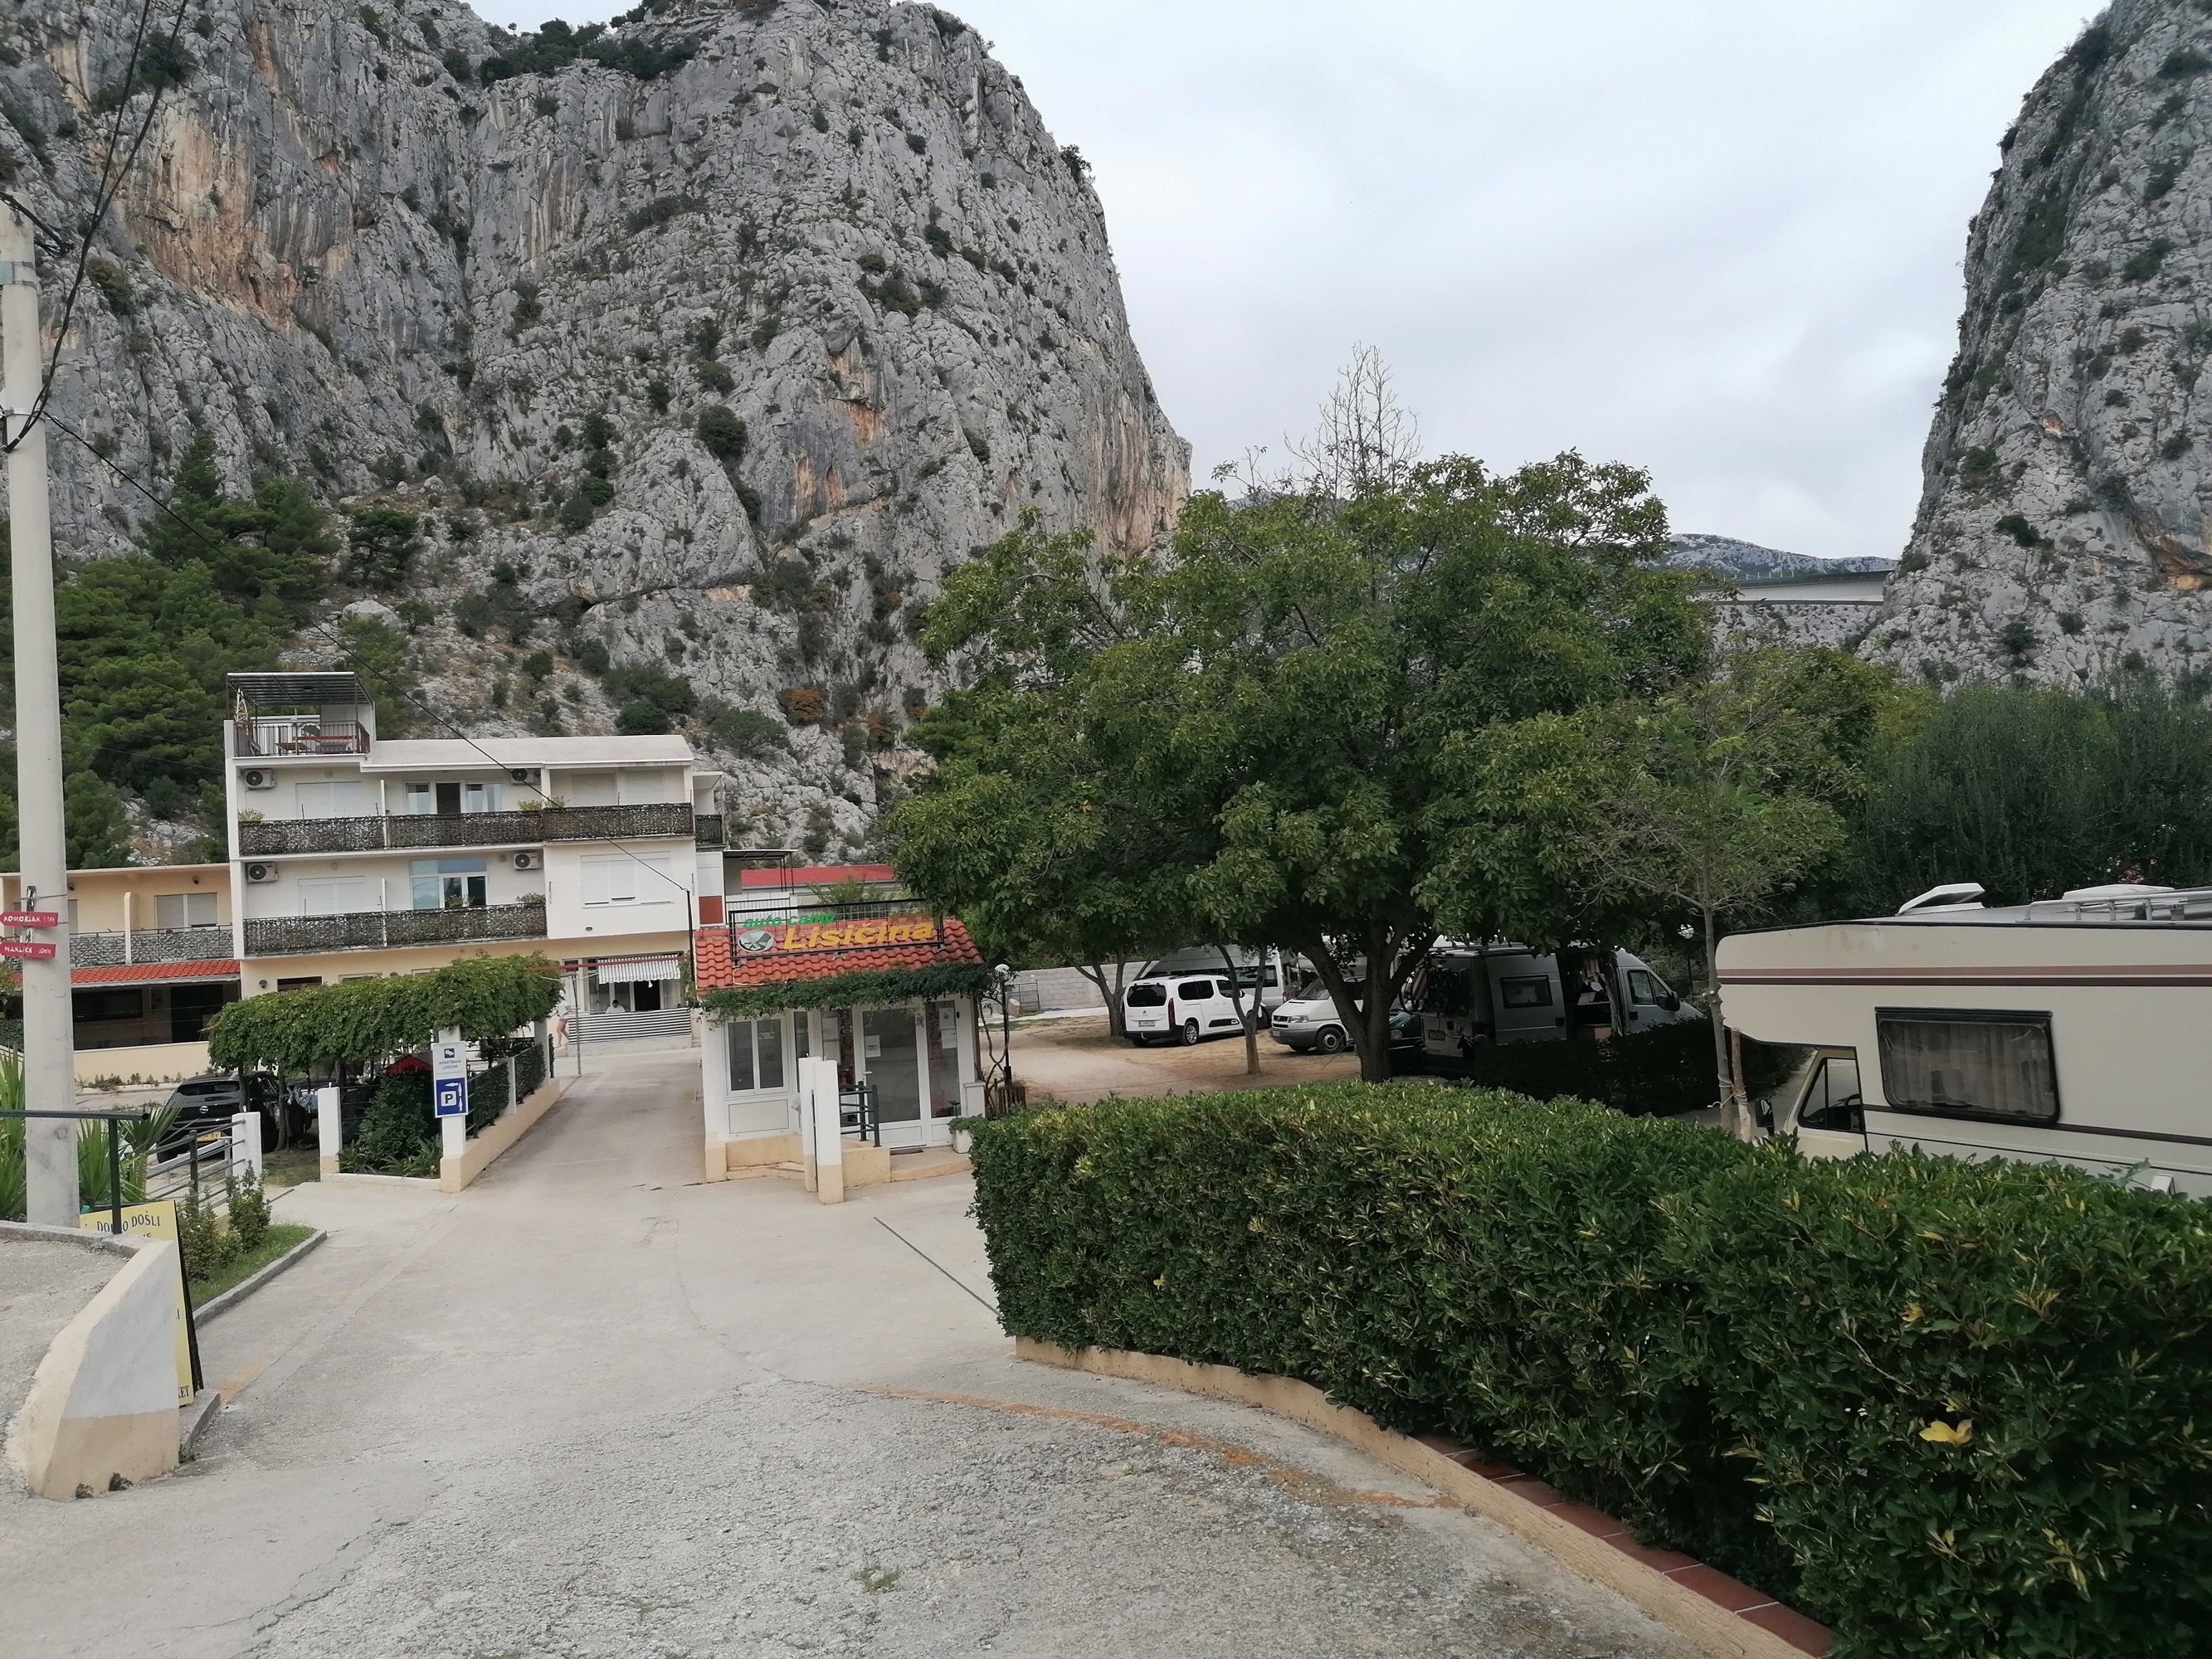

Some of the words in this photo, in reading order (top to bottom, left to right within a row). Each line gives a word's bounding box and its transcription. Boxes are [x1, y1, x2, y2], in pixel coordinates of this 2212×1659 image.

[743, 914, 782, 927] auto
[787, 912, 836, 926] camp
[783, 921, 934, 950] Lisičina
[445, 1093, 453, 1104] P
[97, 1220, 129, 1233] DOO
